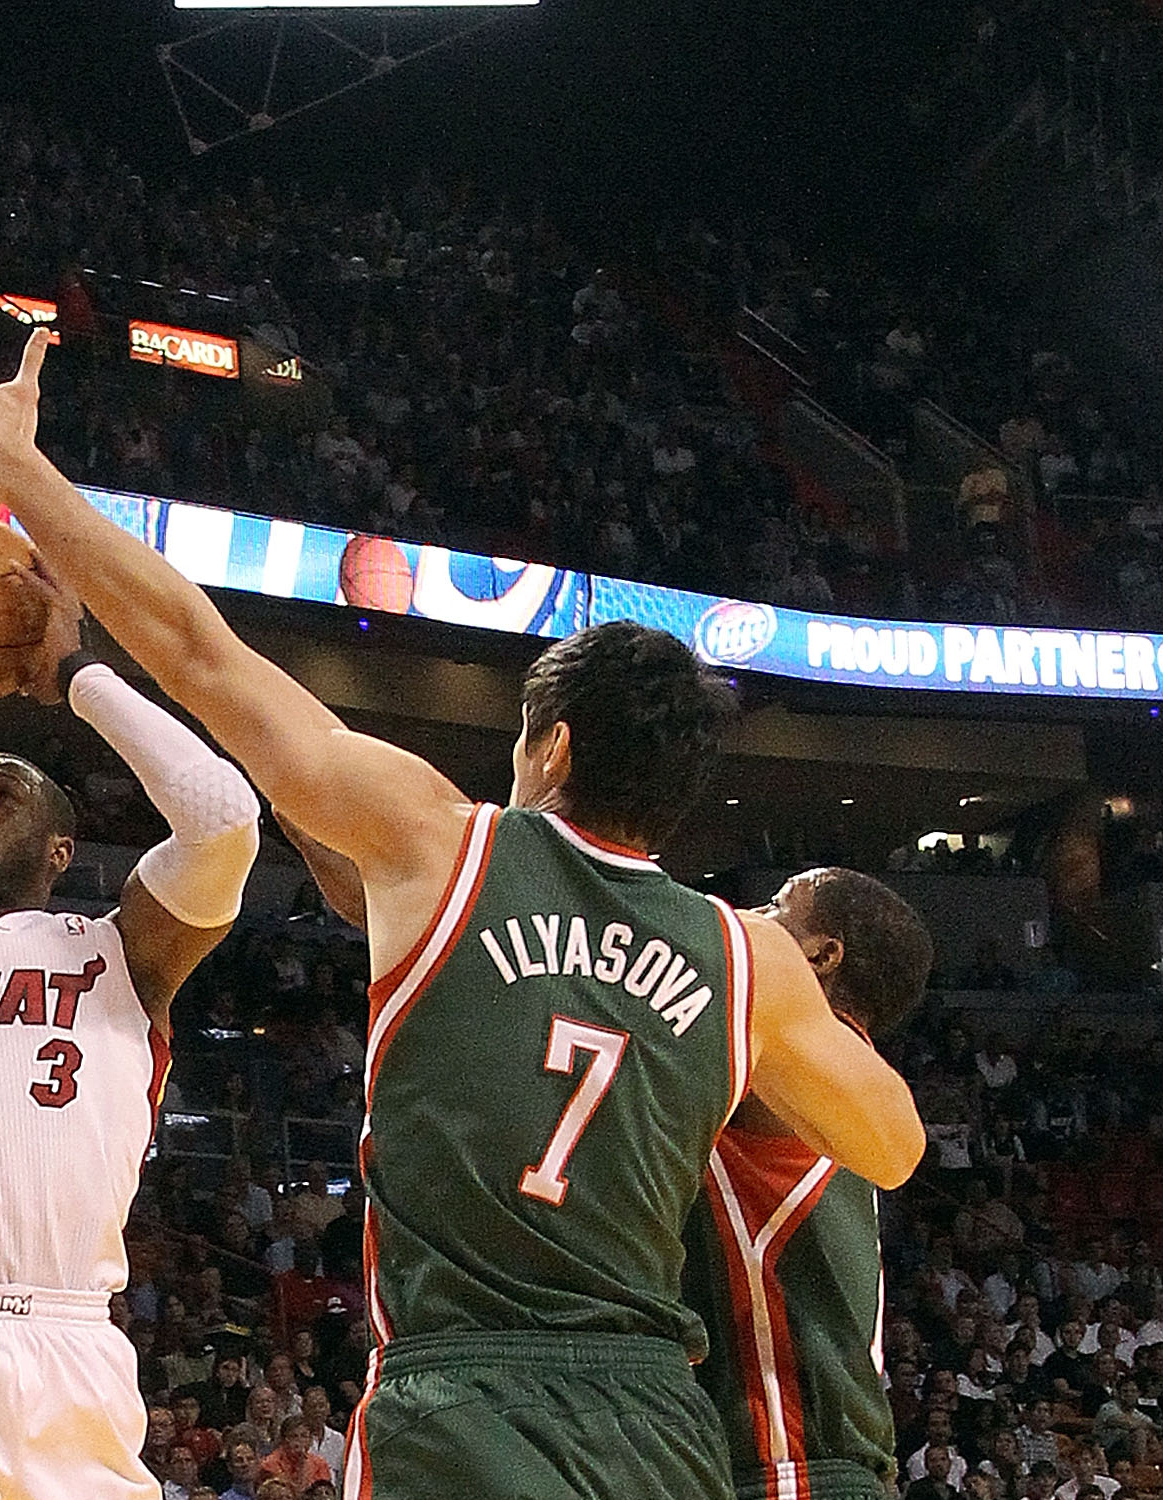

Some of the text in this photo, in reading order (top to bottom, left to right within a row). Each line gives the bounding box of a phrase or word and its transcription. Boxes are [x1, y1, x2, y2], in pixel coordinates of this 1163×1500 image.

[131, 328, 234, 370] BACARDI
[806, 621, 1158, 691] PROUD PARTNER
[479, 914, 713, 1038] ILYASOVA
[29, 1038, 84, 1109] 3
[518, 1013, 630, 1207] 7
